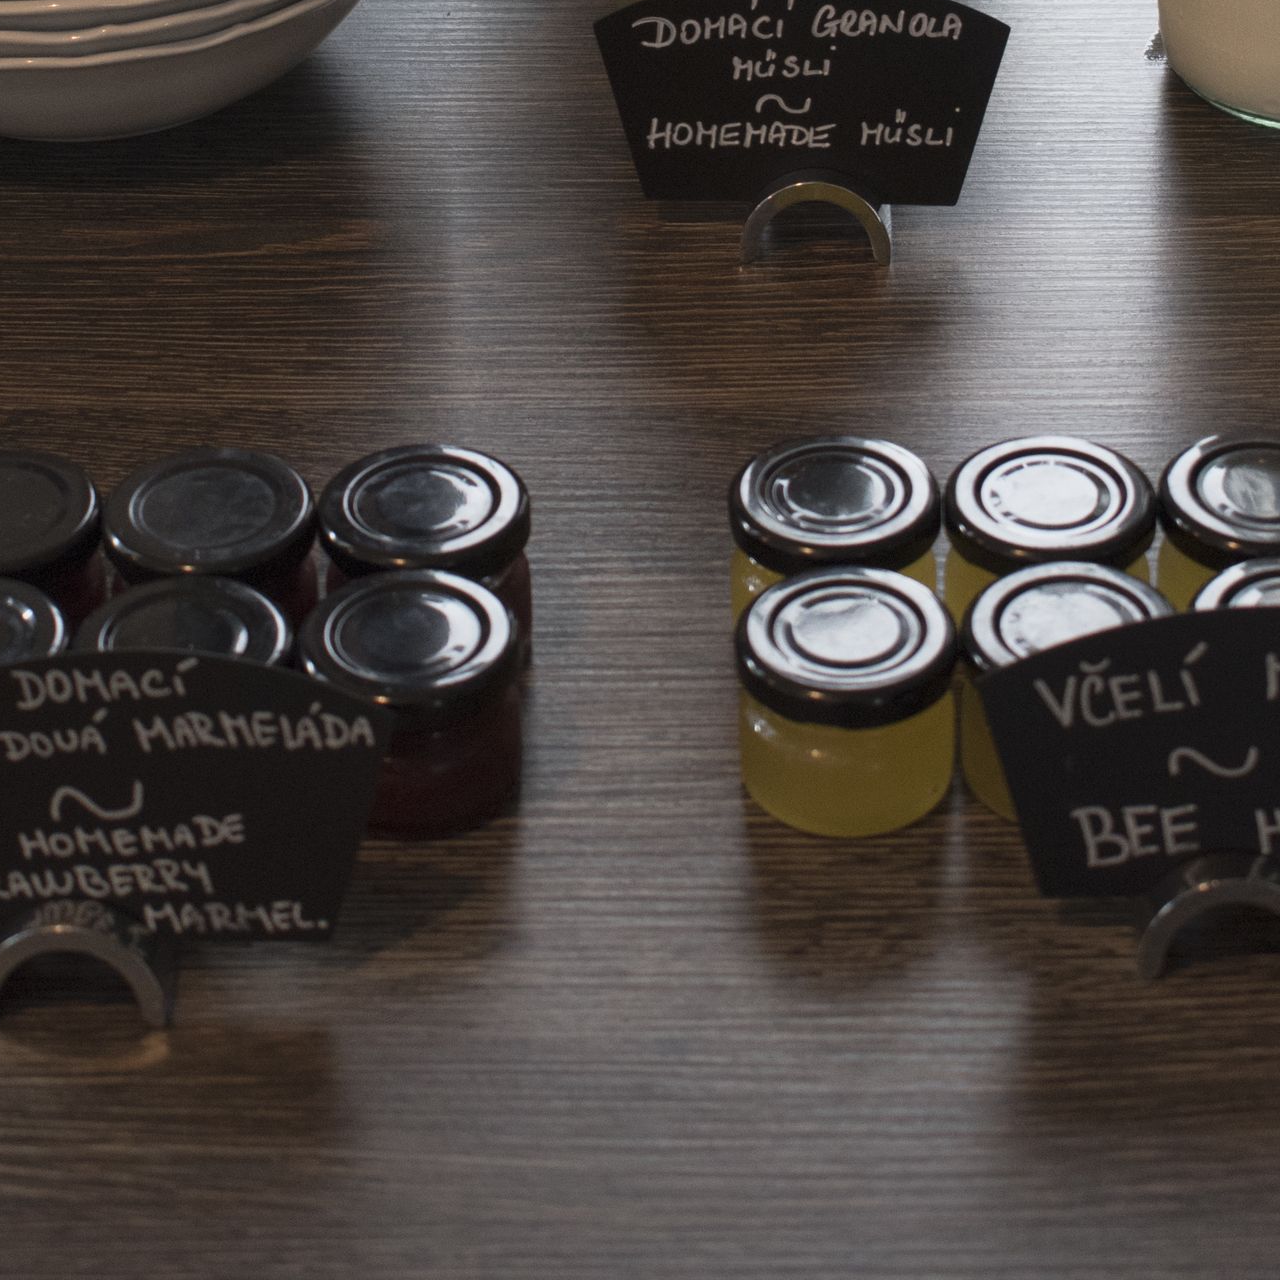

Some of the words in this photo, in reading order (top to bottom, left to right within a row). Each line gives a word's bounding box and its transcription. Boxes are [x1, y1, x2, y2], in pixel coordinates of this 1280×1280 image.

[810, 4, 964, 40] GRANOLA
[646, 117, 838, 149] HOMEMADE
[1033, 640, 1209, 729] VČELÍ
[131, 701, 376, 754] MARMELÁDA
[17, 813, 247, 860] HOMEMADE
[1070, 803, 1201, 868] BEE
